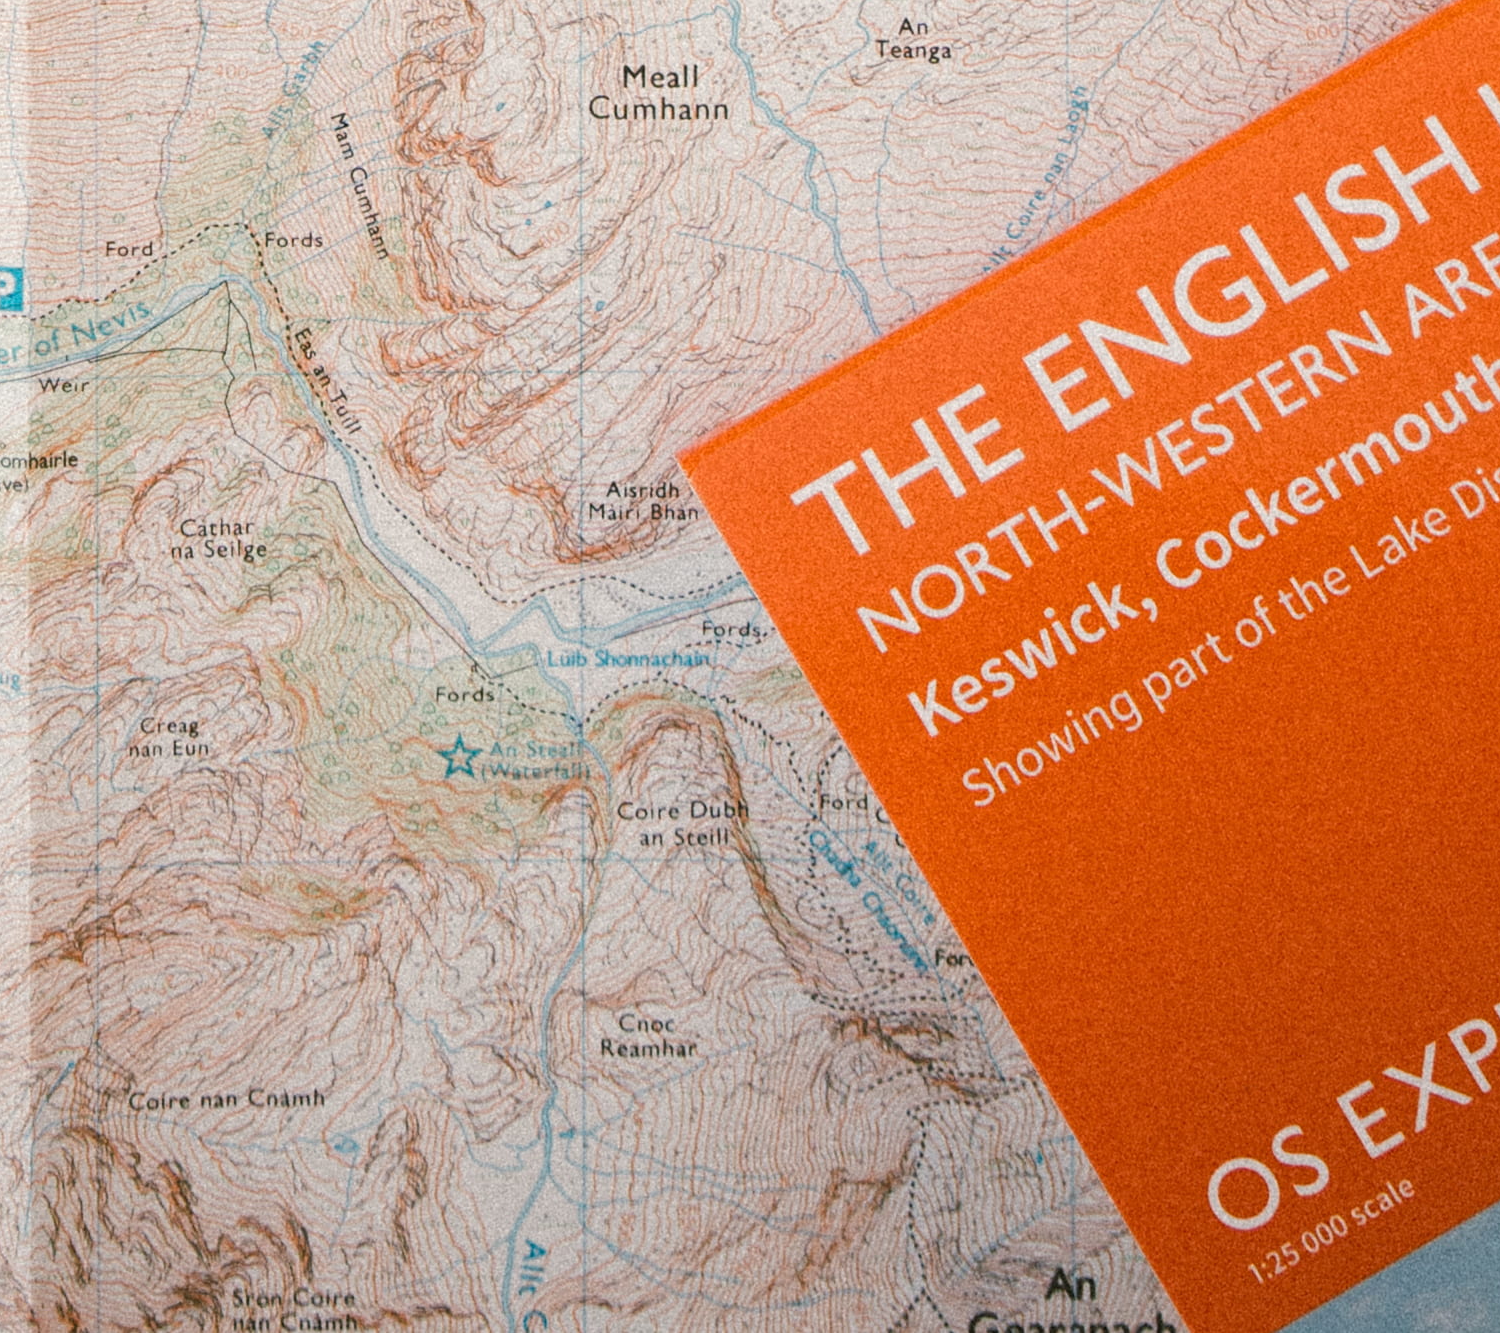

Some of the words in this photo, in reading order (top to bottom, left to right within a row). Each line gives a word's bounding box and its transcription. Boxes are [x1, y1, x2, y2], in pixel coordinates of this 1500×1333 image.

[588, 93, 729, 123] Cumhann
[621, 62, 702, 90] Meall
[35, 330, 61, 363] of
[66, 301, 154, 352] Nevis
[790, 383, 1025, 557] THE
[1022, 115, 1485, 435] ENGLISH
[855, 310, 1394, 654] NORTH-WESTERN
[907, 576, 1161, 738] Keswick,
[960, 688, 1144, 810] Showing
[1141, 632, 1235, 712] part
[1233, 596, 1280, 649] of
[1288, 563, 1354, 623] the
[1360, 504, 1454, 582] Lake
[1207, 1124, 1332, 1232] OS
